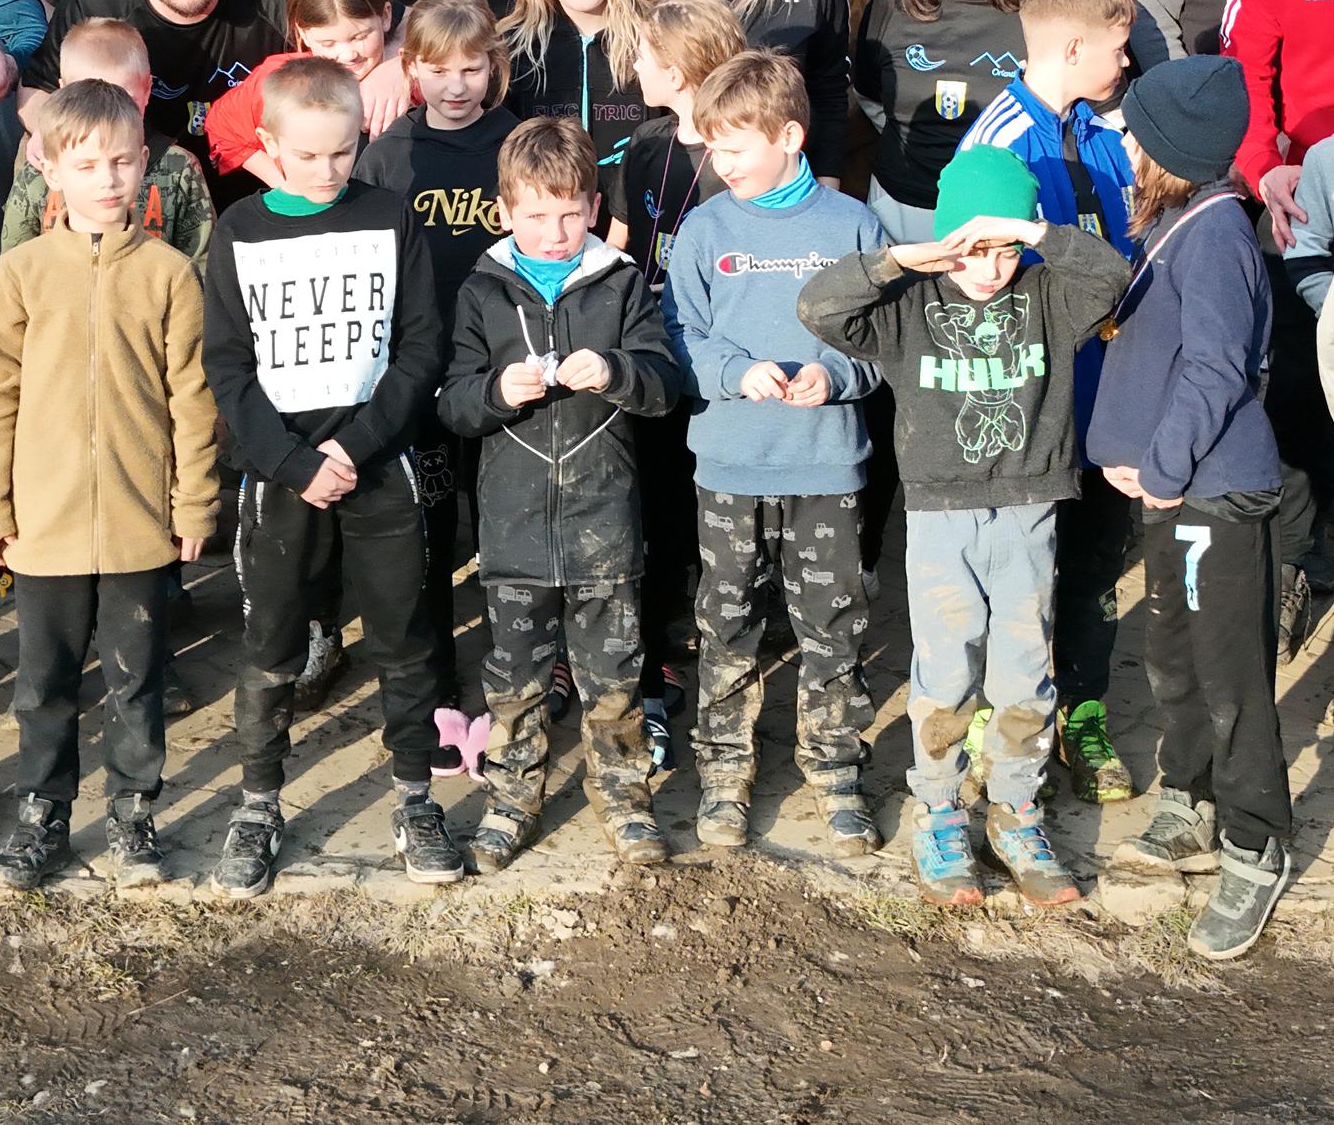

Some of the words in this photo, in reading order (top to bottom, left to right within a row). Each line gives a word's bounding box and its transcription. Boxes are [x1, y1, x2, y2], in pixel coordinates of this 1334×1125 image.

[239, 252, 284, 266] THE
[315, 243, 379, 258] CITY
[248, 272, 385, 323] NEVER
[919, 343, 1046, 392] HULK
[1175, 524, 1212, 611] 7
